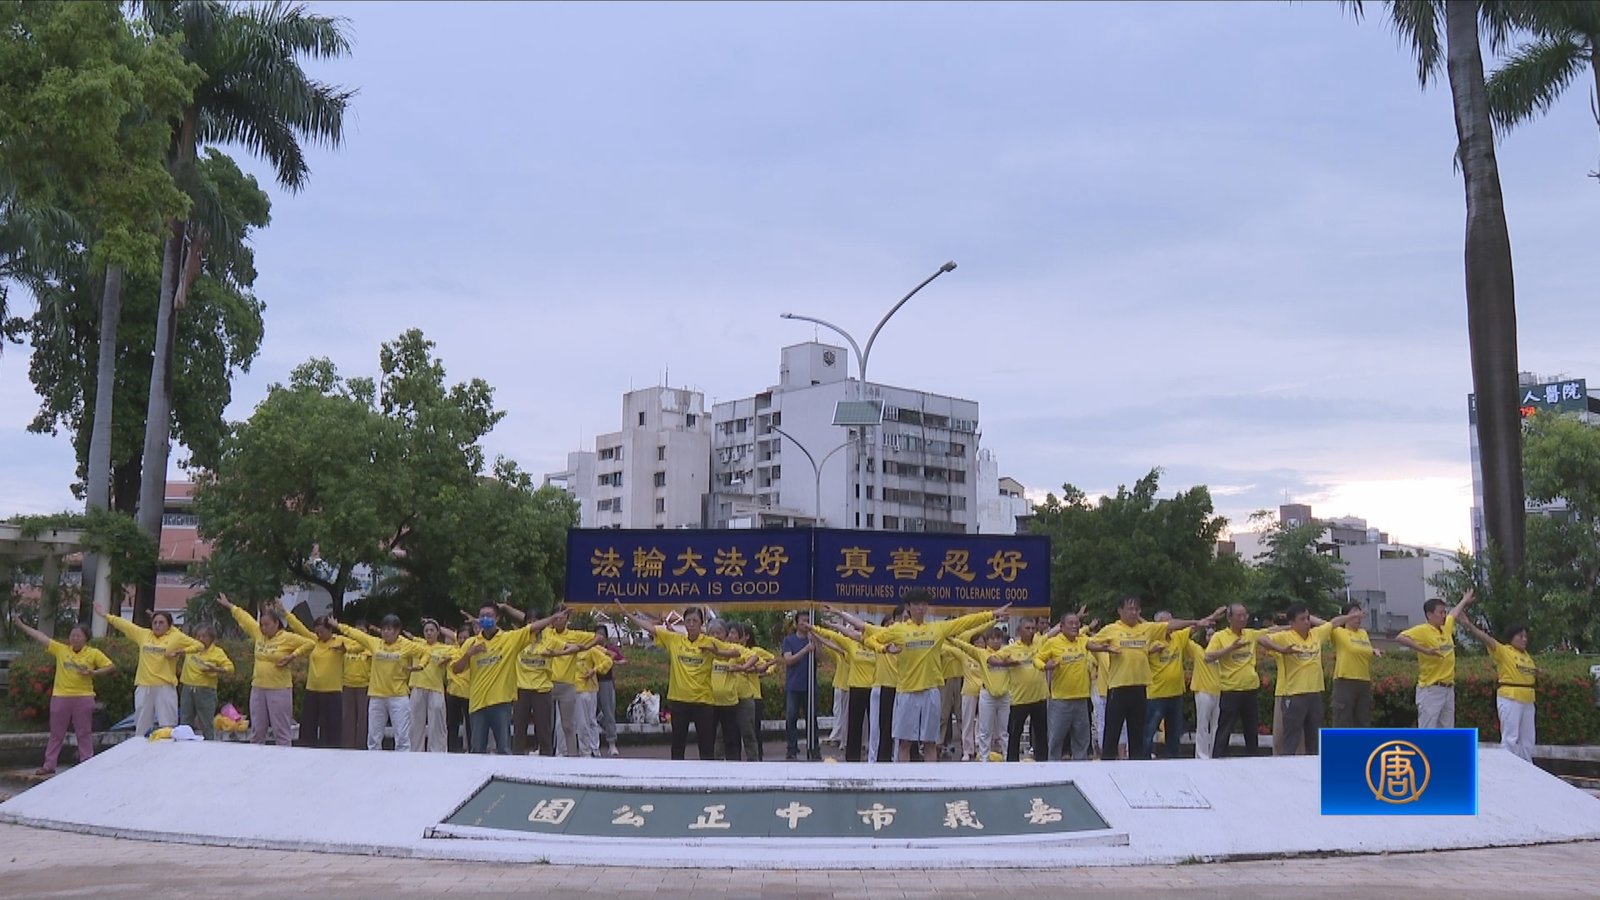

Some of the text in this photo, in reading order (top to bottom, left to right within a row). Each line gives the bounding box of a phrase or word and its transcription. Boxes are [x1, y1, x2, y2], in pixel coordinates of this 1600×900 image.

[590, 545, 789, 578] 法輪大法好
[835, 546, 1028, 583] 真善忍好
[597, 581, 780, 596] FALUN DAFA IS GOOD
[835, 583, 1028, 600] TRUTHFULNESS COSSION TOLERANCE GOOD
